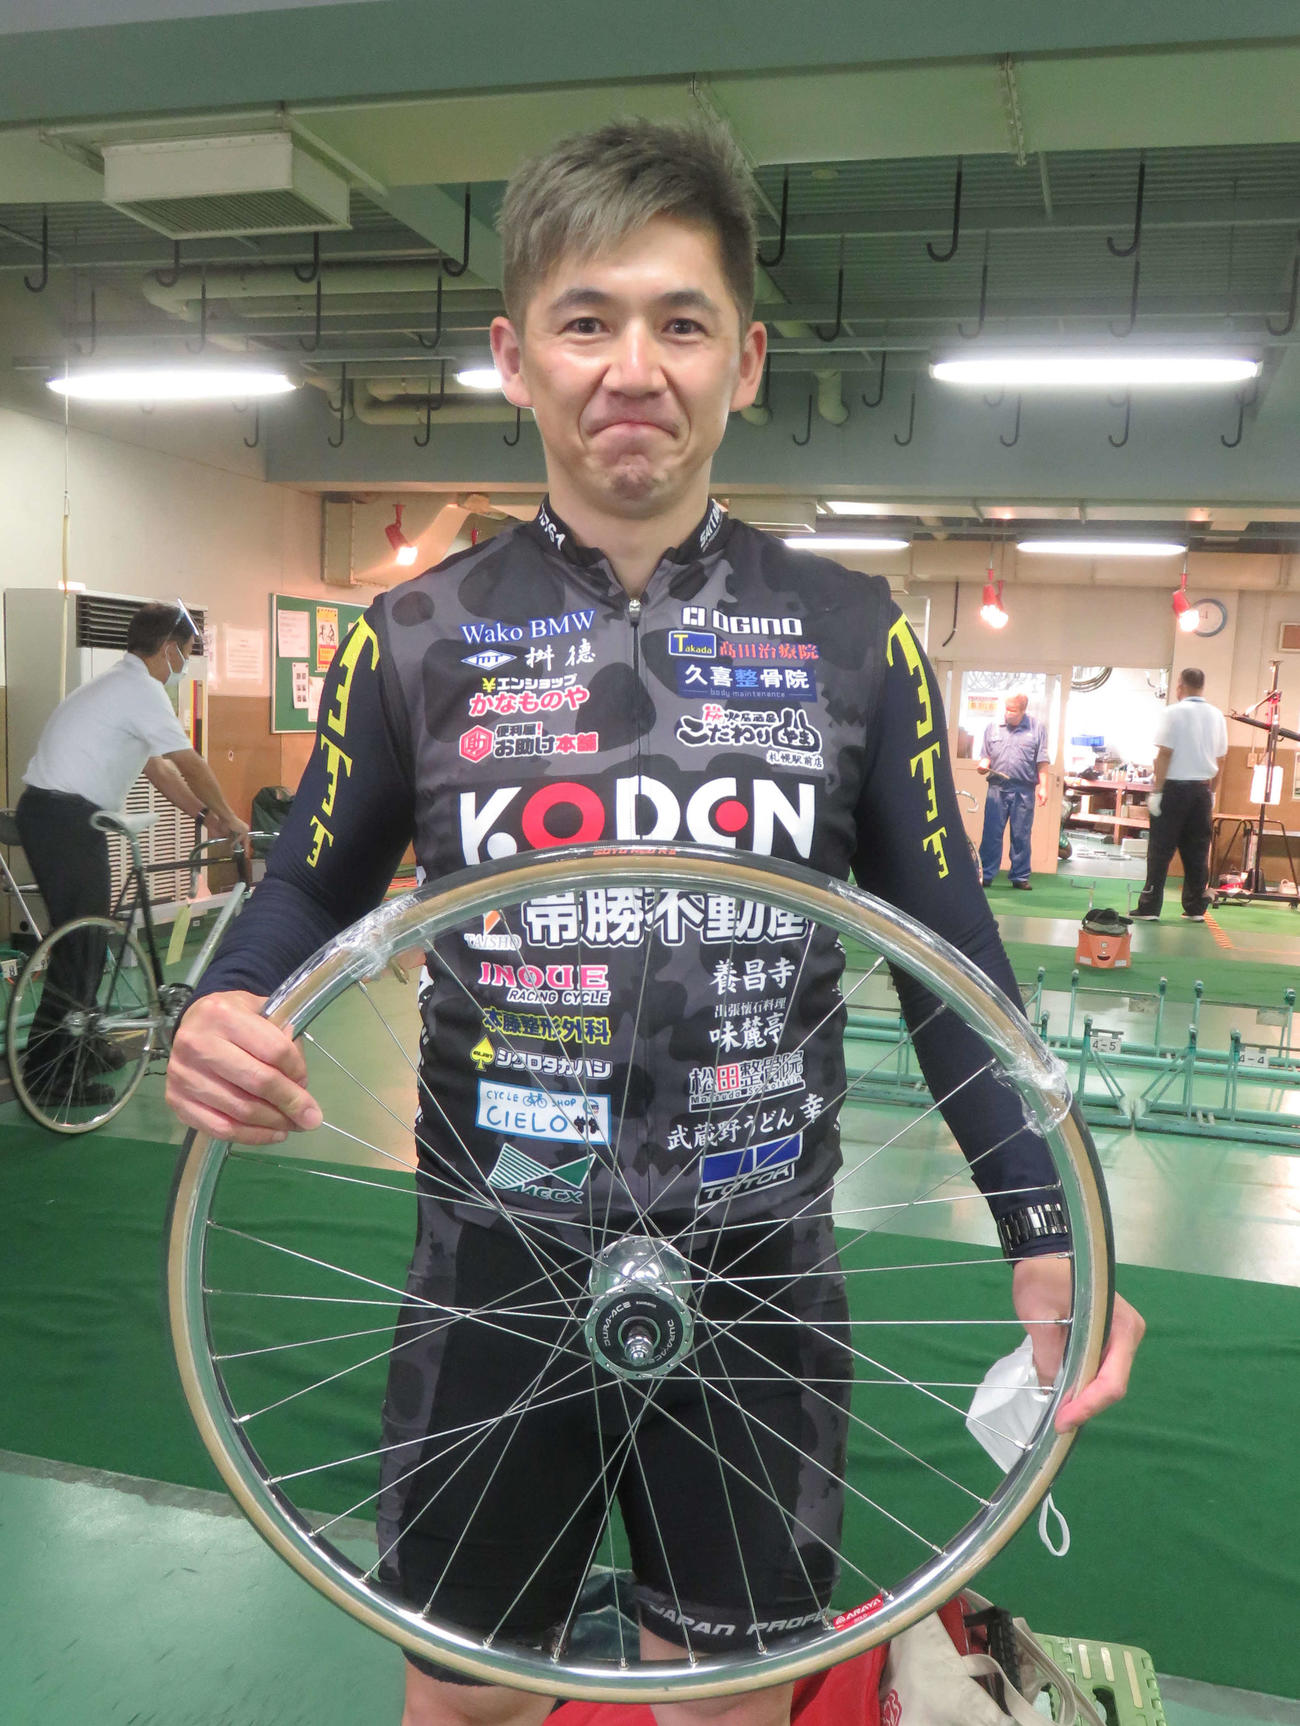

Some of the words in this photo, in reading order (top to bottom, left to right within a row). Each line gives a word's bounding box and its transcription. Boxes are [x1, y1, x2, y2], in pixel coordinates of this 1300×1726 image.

[461, 620, 524, 644] Wako
[530, 610, 595, 639] BMW
[712, 609, 803, 636] OGINO
[673, 634, 713, 655] Takada
[684, 663, 811, 690] 久喜整骨院
[469, 684, 591, 717] かなものや
[478, 962, 609, 991] INOUE
[709, 957, 796, 996] 養昌寺
[507, 988, 558, 1004] RACING
[561, 991, 612, 1006] CYCLE
[1092, 1039, 1117, 1052] 4-5
[495, 1048, 612, 1080] シクロタカハシ
[486, 1090, 519, 1103] CYCLE
[551, 1099, 577, 1108] SHOP
[486, 1105, 569, 1133] CIELO
[667, 1108, 795, 1151] 武蔵野うどん
[799, 1093, 825, 1124] 幸
[603, 1301, 632, 1348] DURA-ACE
[655, 1319, 677, 1362] DURA-AC
[650, 1604, 736, 1637] JAPAN
[846, 1598, 882, 1618] ARAYA
